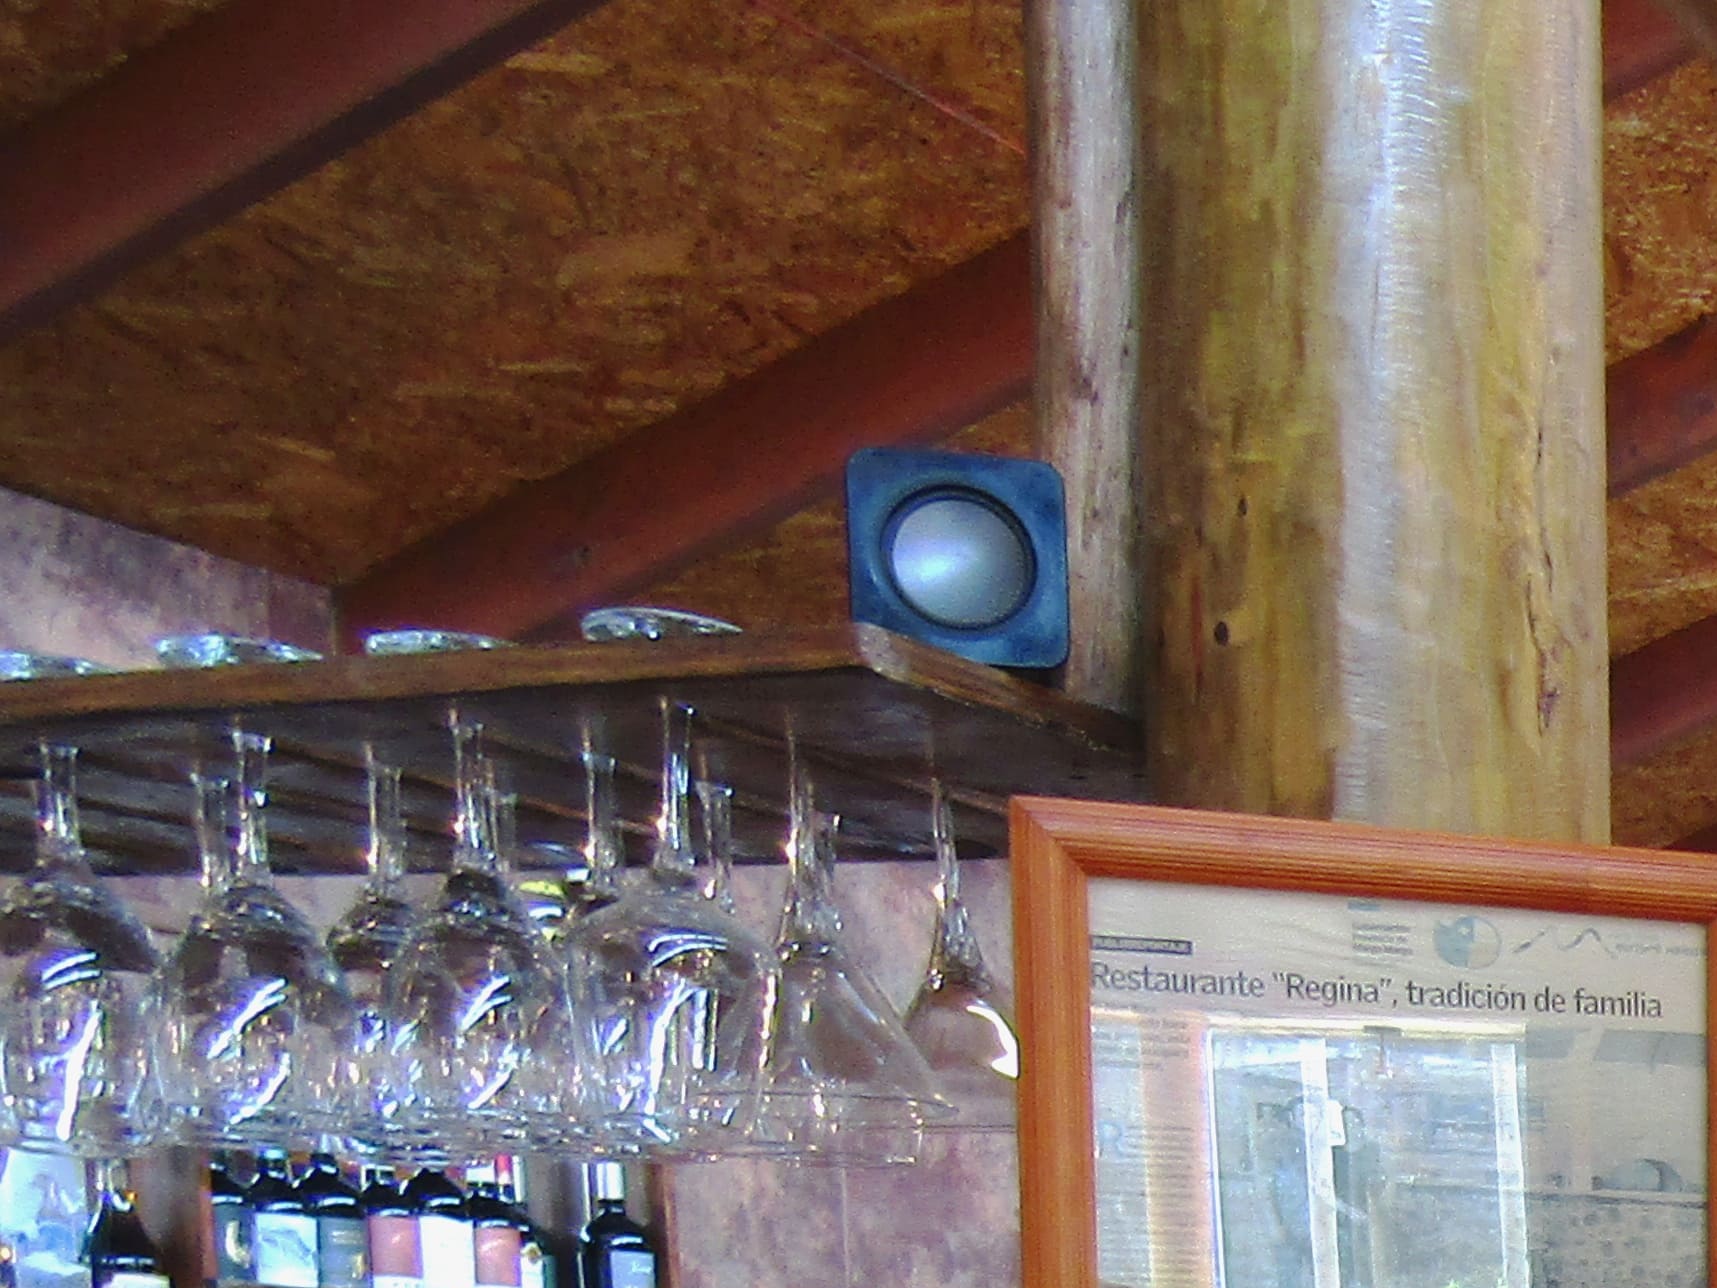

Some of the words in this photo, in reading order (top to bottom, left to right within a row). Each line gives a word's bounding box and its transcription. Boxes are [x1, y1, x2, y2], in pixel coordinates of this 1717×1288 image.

[1091, 962, 1265, 998] Restaurante
[1405, 980, 1527, 1012] tradición
[1534, 986, 1566, 1014] de
[1574, 988, 1664, 1018] familia
